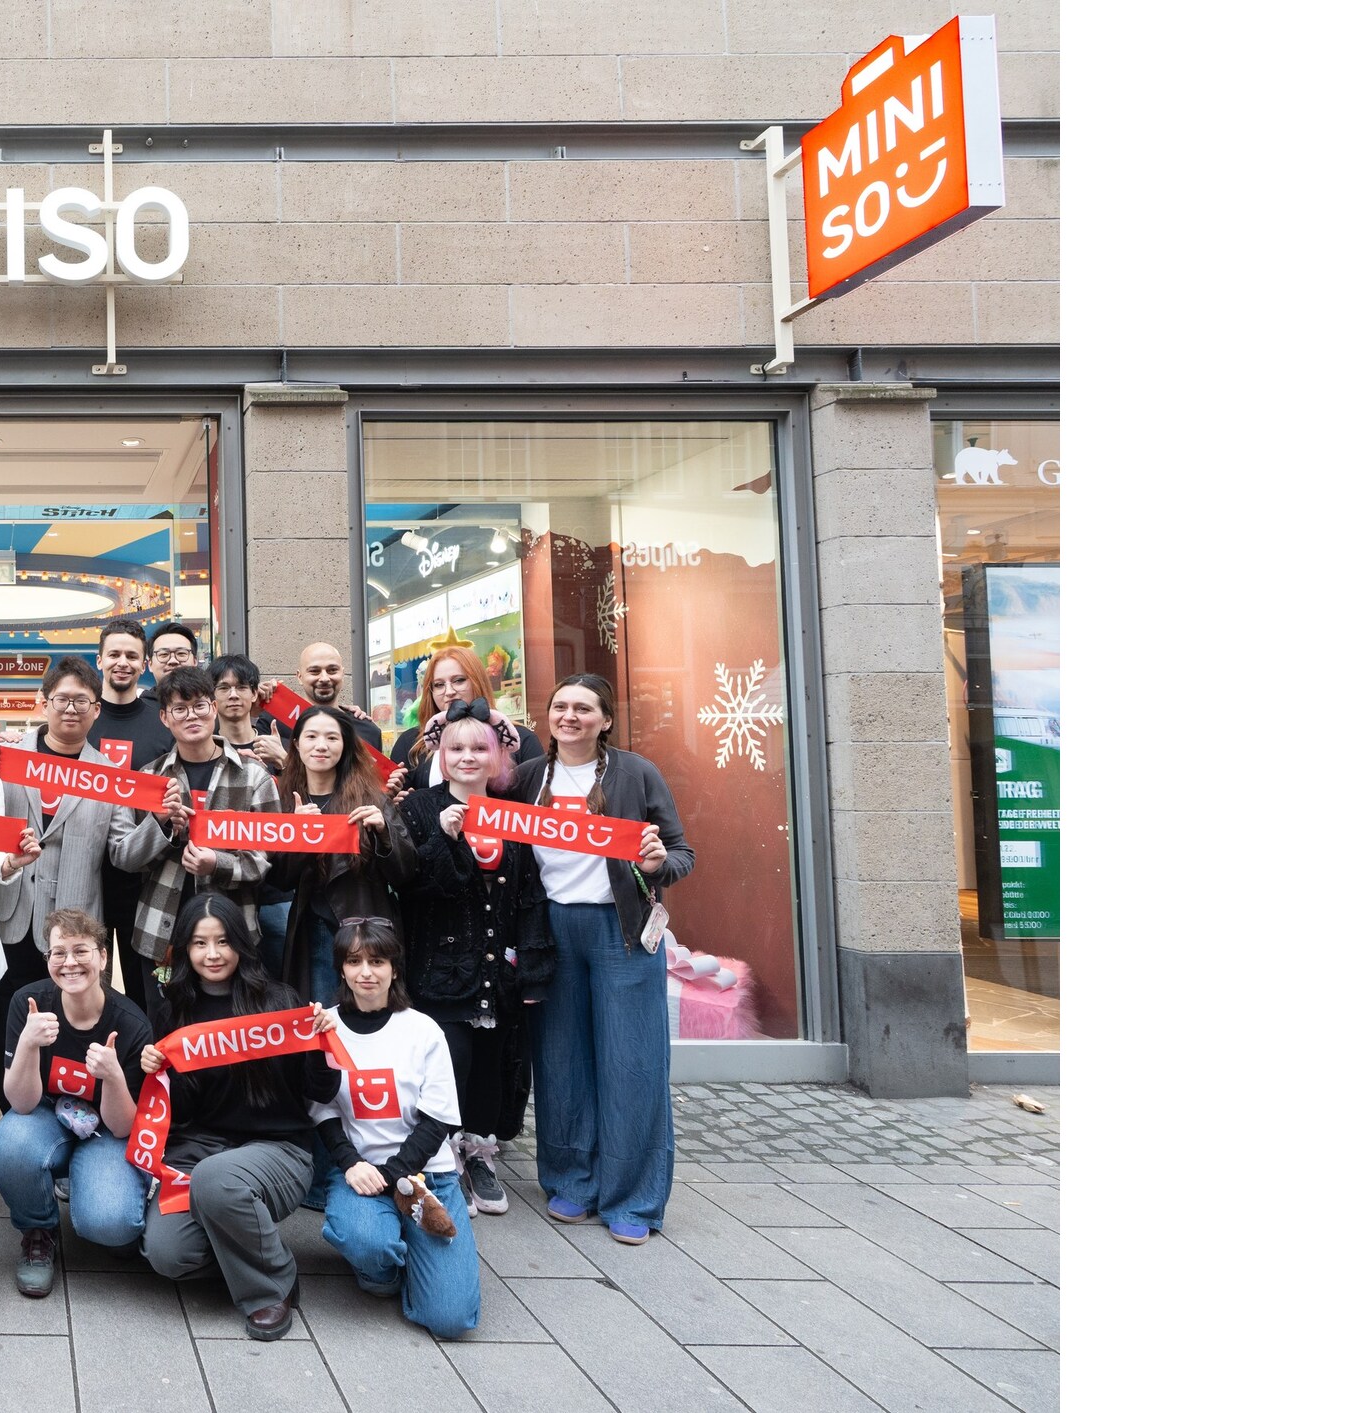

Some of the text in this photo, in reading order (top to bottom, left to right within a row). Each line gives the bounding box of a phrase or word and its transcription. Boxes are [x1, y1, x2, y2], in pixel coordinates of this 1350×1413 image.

[817, 60, 944, 199] MINI
[6, 662, 16, 672] IP
[17, 662, 44, 672] ZONE
[25, 759, 109, 793] MINISO
[207, 819, 295, 843] MINISO
[477, 806, 579, 842] MINISO
[182, 1023, 286, 1061] MINISO
